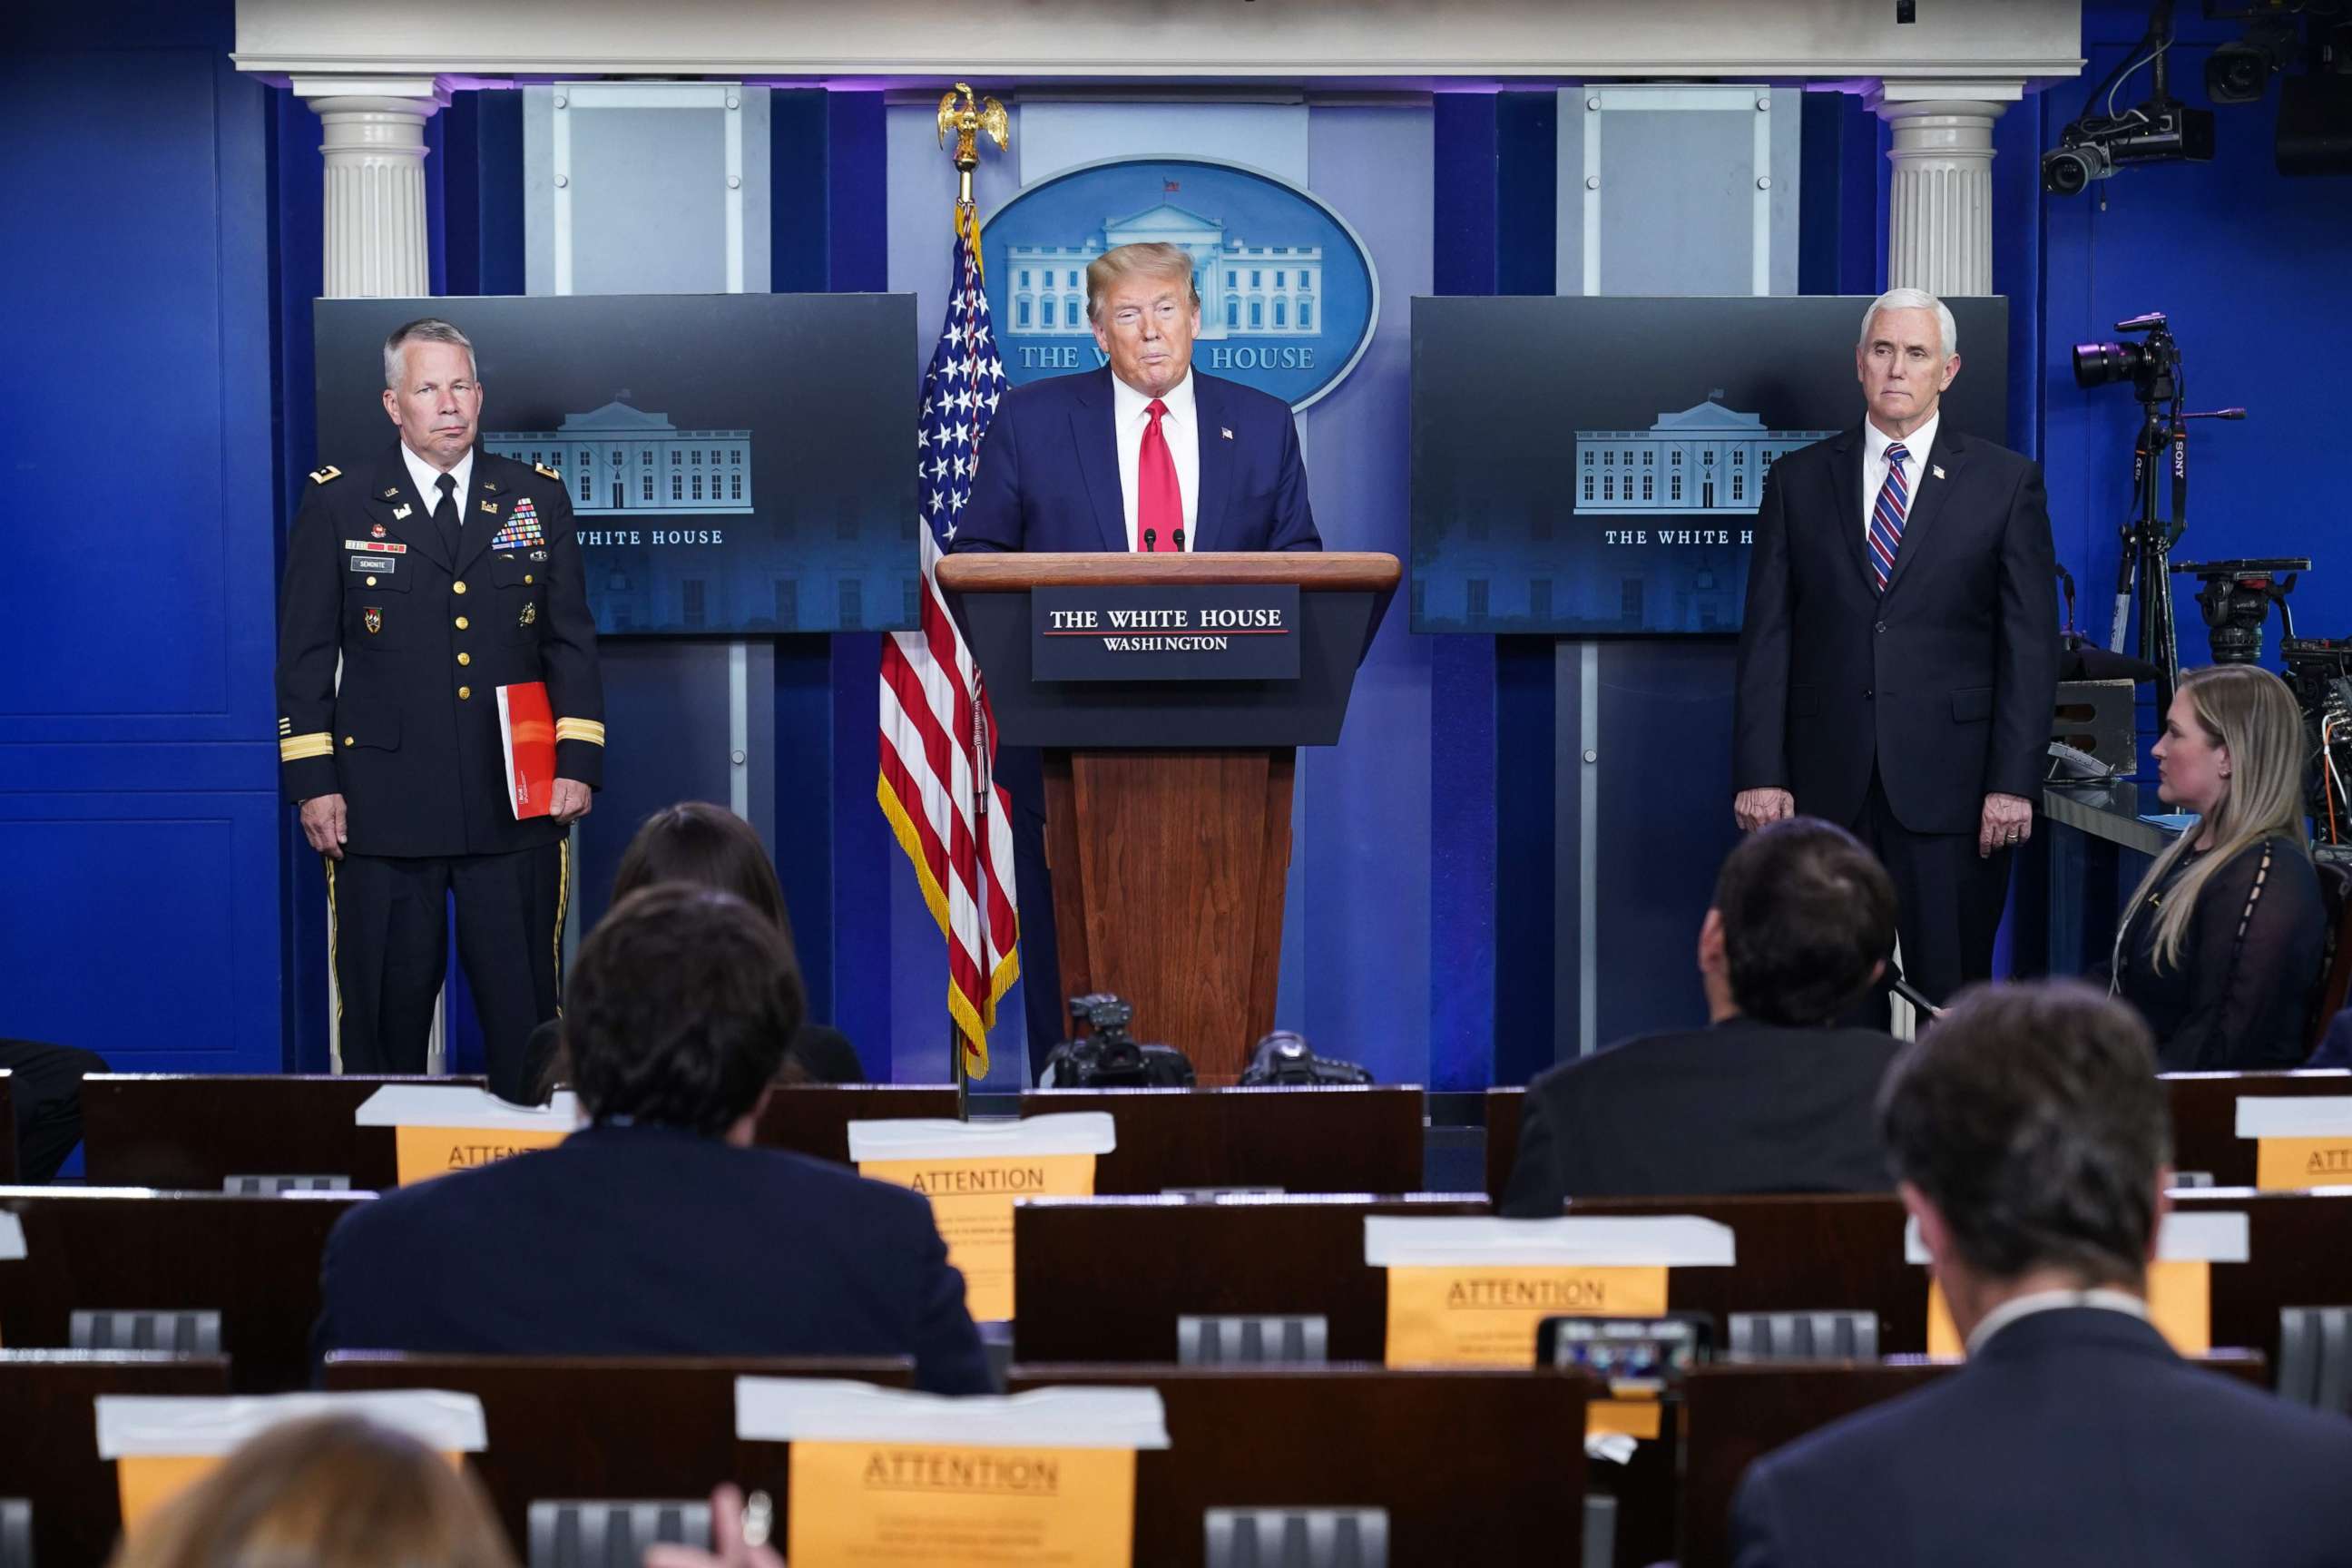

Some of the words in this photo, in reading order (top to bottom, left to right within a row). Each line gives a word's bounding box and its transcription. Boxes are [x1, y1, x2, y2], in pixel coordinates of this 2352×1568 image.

[1018, 347, 1079, 368] THE
[1211, 347, 1315, 369] HOUSE
[2175, 441, 2184, 479] SONY
[652, 530, 723, 544] HOUSE
[1605, 530, 1647, 544] THE
[1658, 530, 1729, 544] WHITE
[1050, 611, 1098, 629] THE
[1107, 610, 1189, 628] WHITE
[1200, 609, 1281, 628] HOUSE
[1102, 636, 1228, 652] WASHINGTON
[910, 1168, 1044, 1192] ATTENTION
[1448, 1278, 1606, 1307] ATTENTION
[863, 1451, 1059, 1493] ATTENTION
